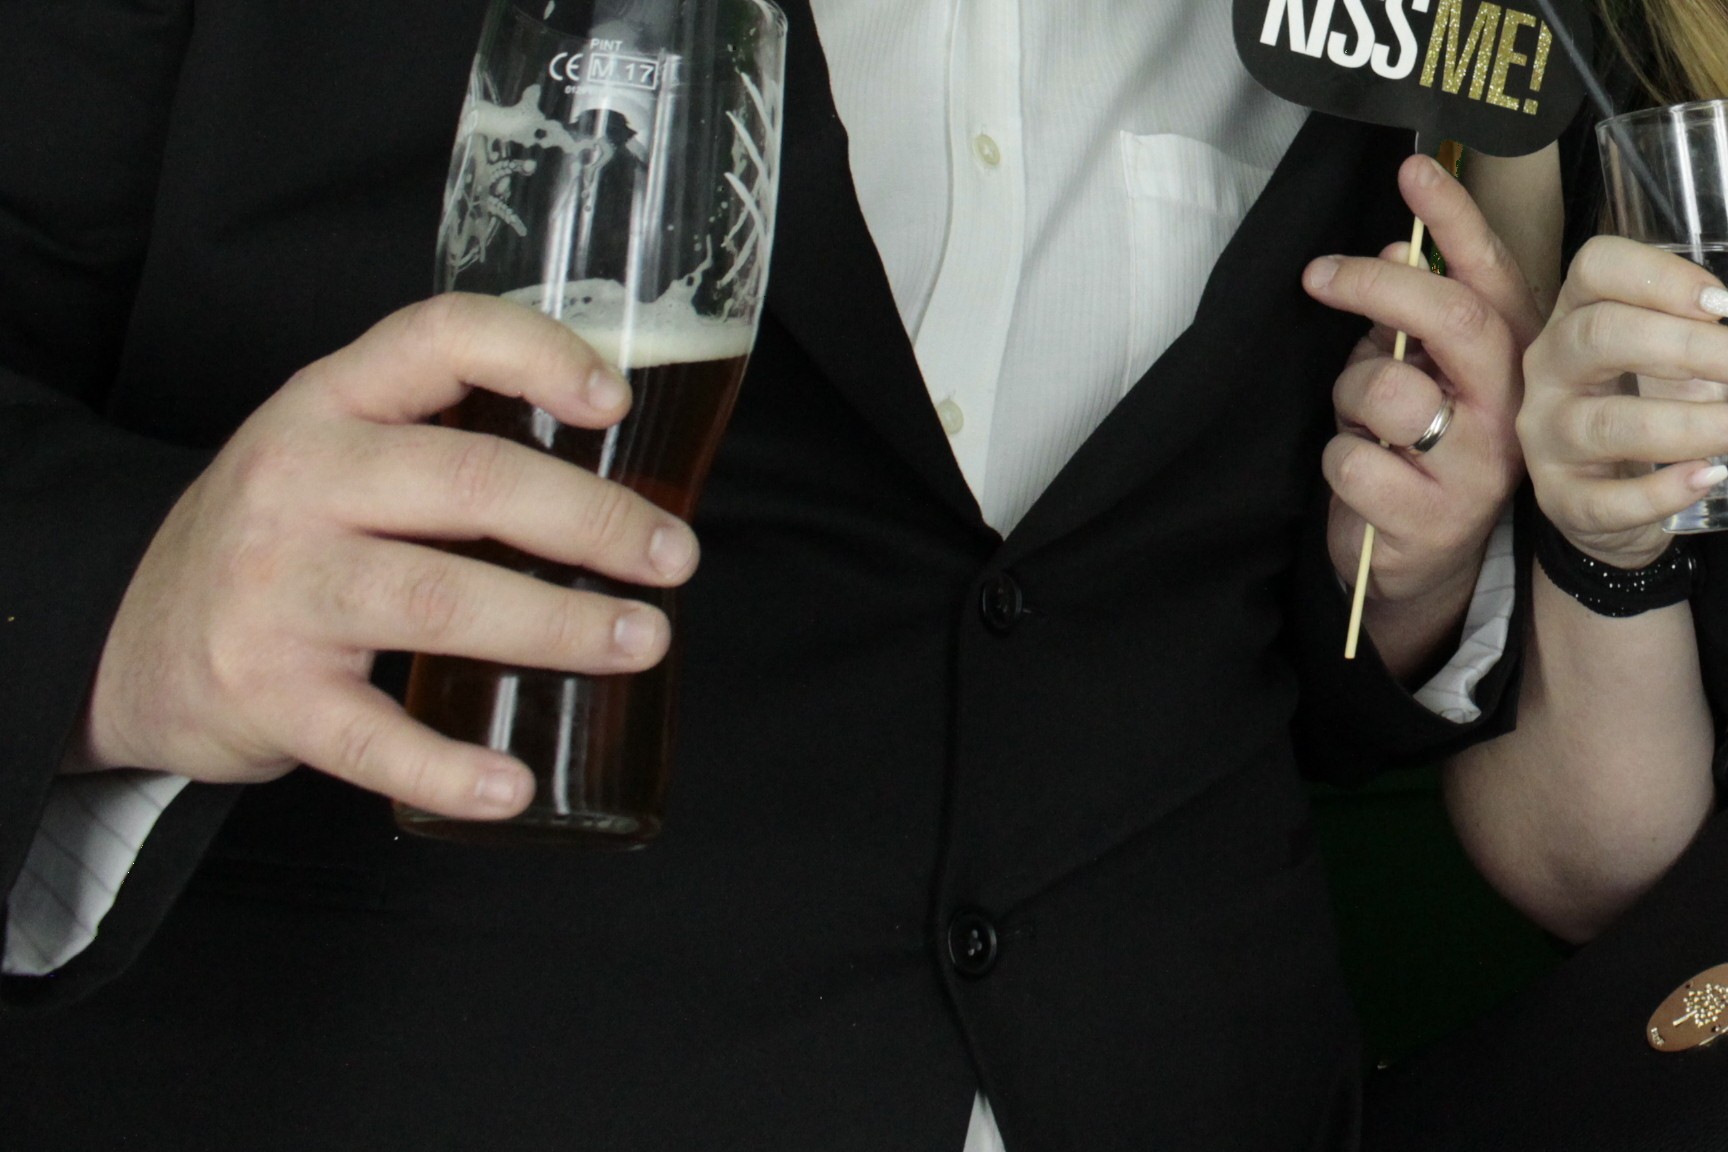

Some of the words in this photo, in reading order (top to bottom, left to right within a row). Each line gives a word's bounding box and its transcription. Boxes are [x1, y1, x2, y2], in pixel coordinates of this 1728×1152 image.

[590, 38, 623, 51] PINT
[549, 52, 584, 81] CE
[625, 63, 655, 83] 17
